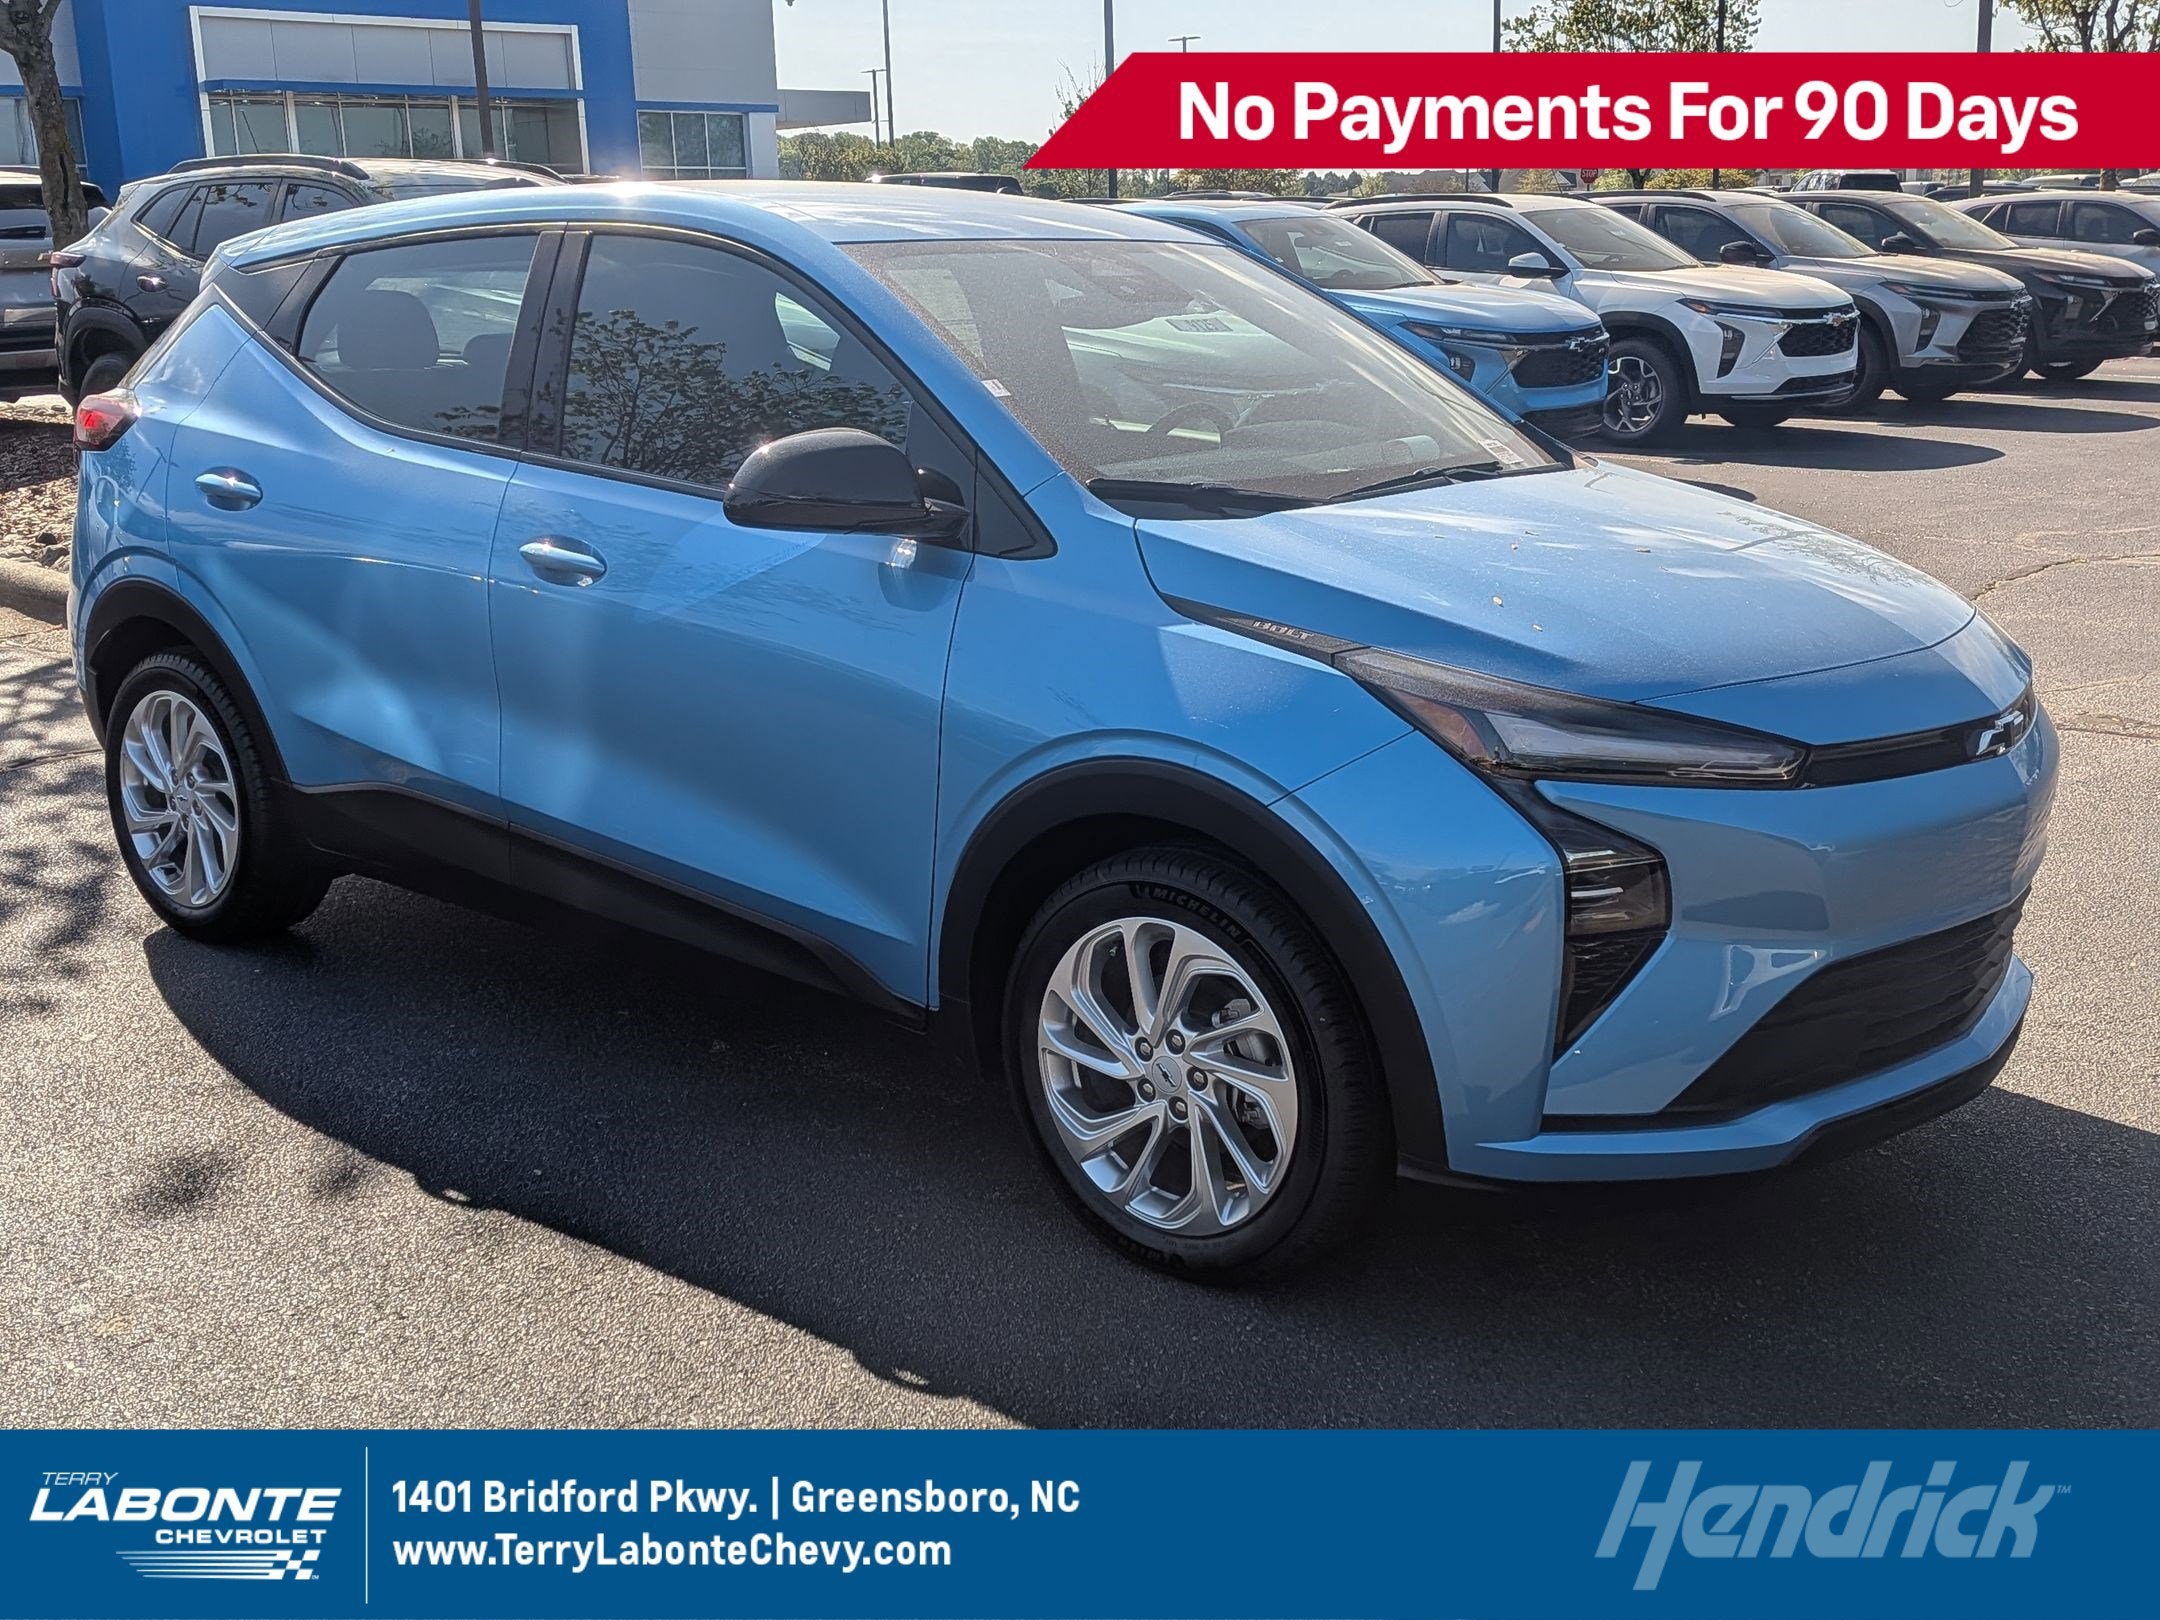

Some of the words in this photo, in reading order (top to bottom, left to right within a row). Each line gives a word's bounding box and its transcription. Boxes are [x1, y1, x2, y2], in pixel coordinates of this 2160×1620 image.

[1581, 169, 1598, 178] STOP
[1253, 621, 1314, 640] BOLT
[1152, 886, 1241, 940] MICHELIN
